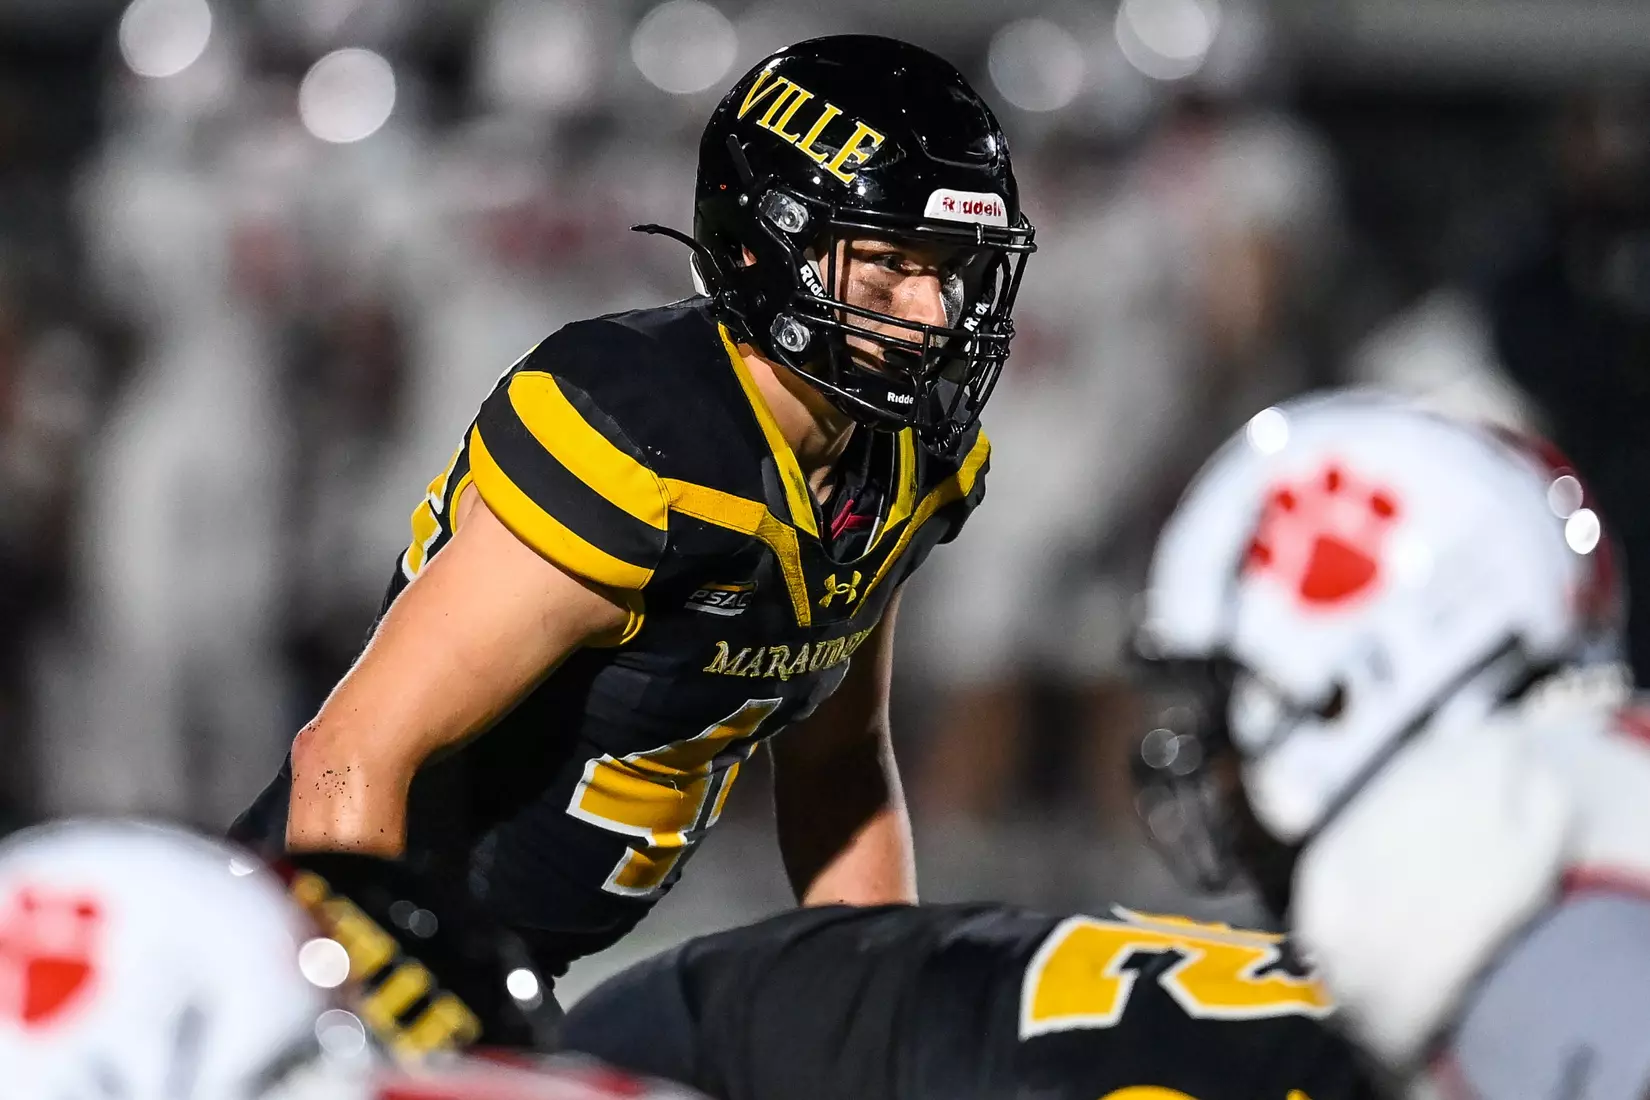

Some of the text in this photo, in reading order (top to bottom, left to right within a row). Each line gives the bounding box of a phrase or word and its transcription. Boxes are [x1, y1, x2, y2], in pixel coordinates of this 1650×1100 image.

[737, 69, 886, 185] VILLE
[688, 589, 753, 607] PSAC
[702, 628, 872, 682] MARAUD
